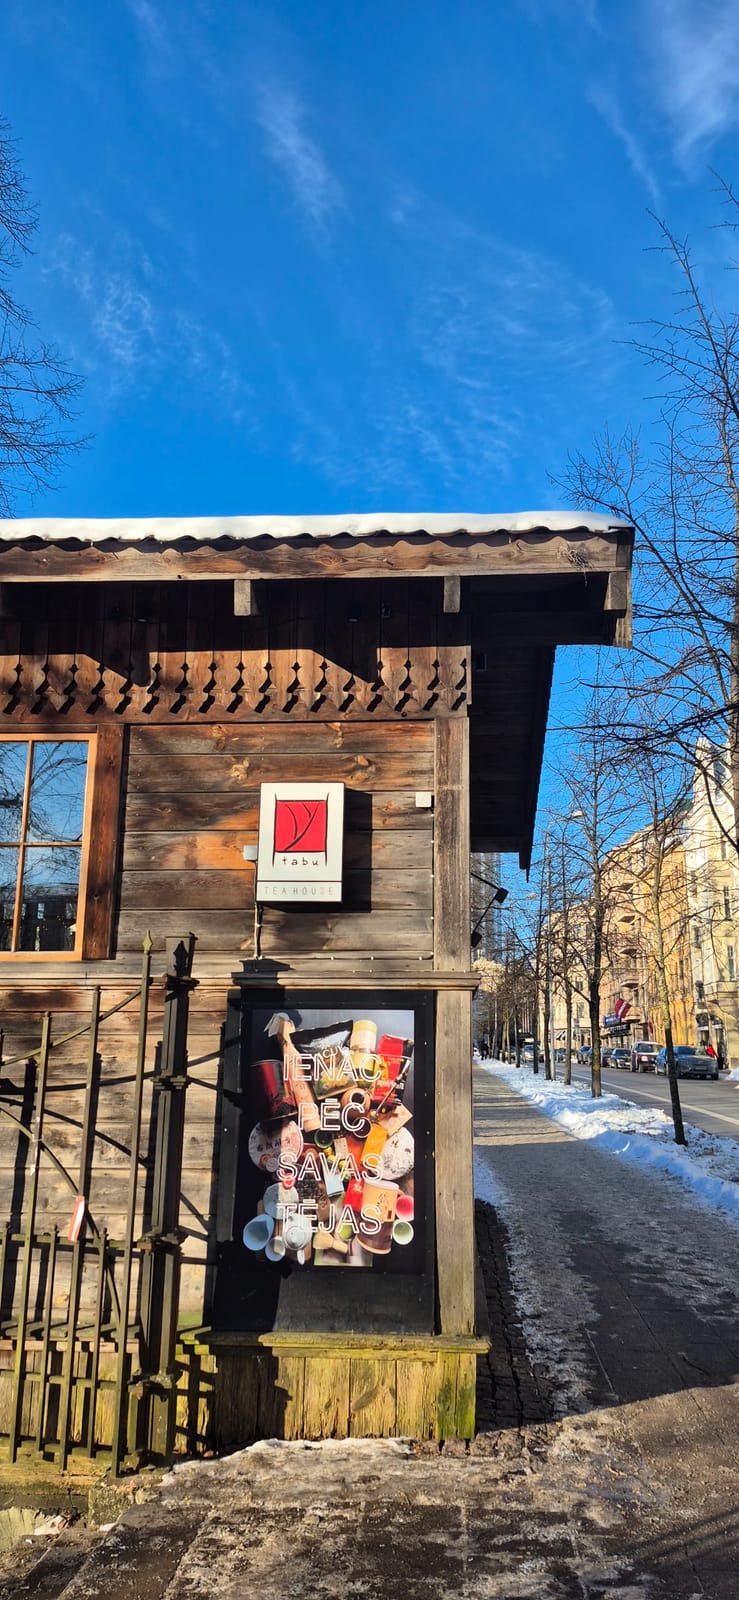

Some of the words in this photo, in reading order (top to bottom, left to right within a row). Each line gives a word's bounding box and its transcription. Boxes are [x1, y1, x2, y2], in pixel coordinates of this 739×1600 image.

[282, 856, 319, 866] tabu
[264, 886, 287, 896] TEA
[293, 886, 335, 896] HOUSE
[282, 1050, 382, 1083] IENĀC
[297, 1097, 366, 1132] PĒC
[277, 1152, 382, 1181] SAVAS
[276, 1199, 381, 1235] TĒJAS
